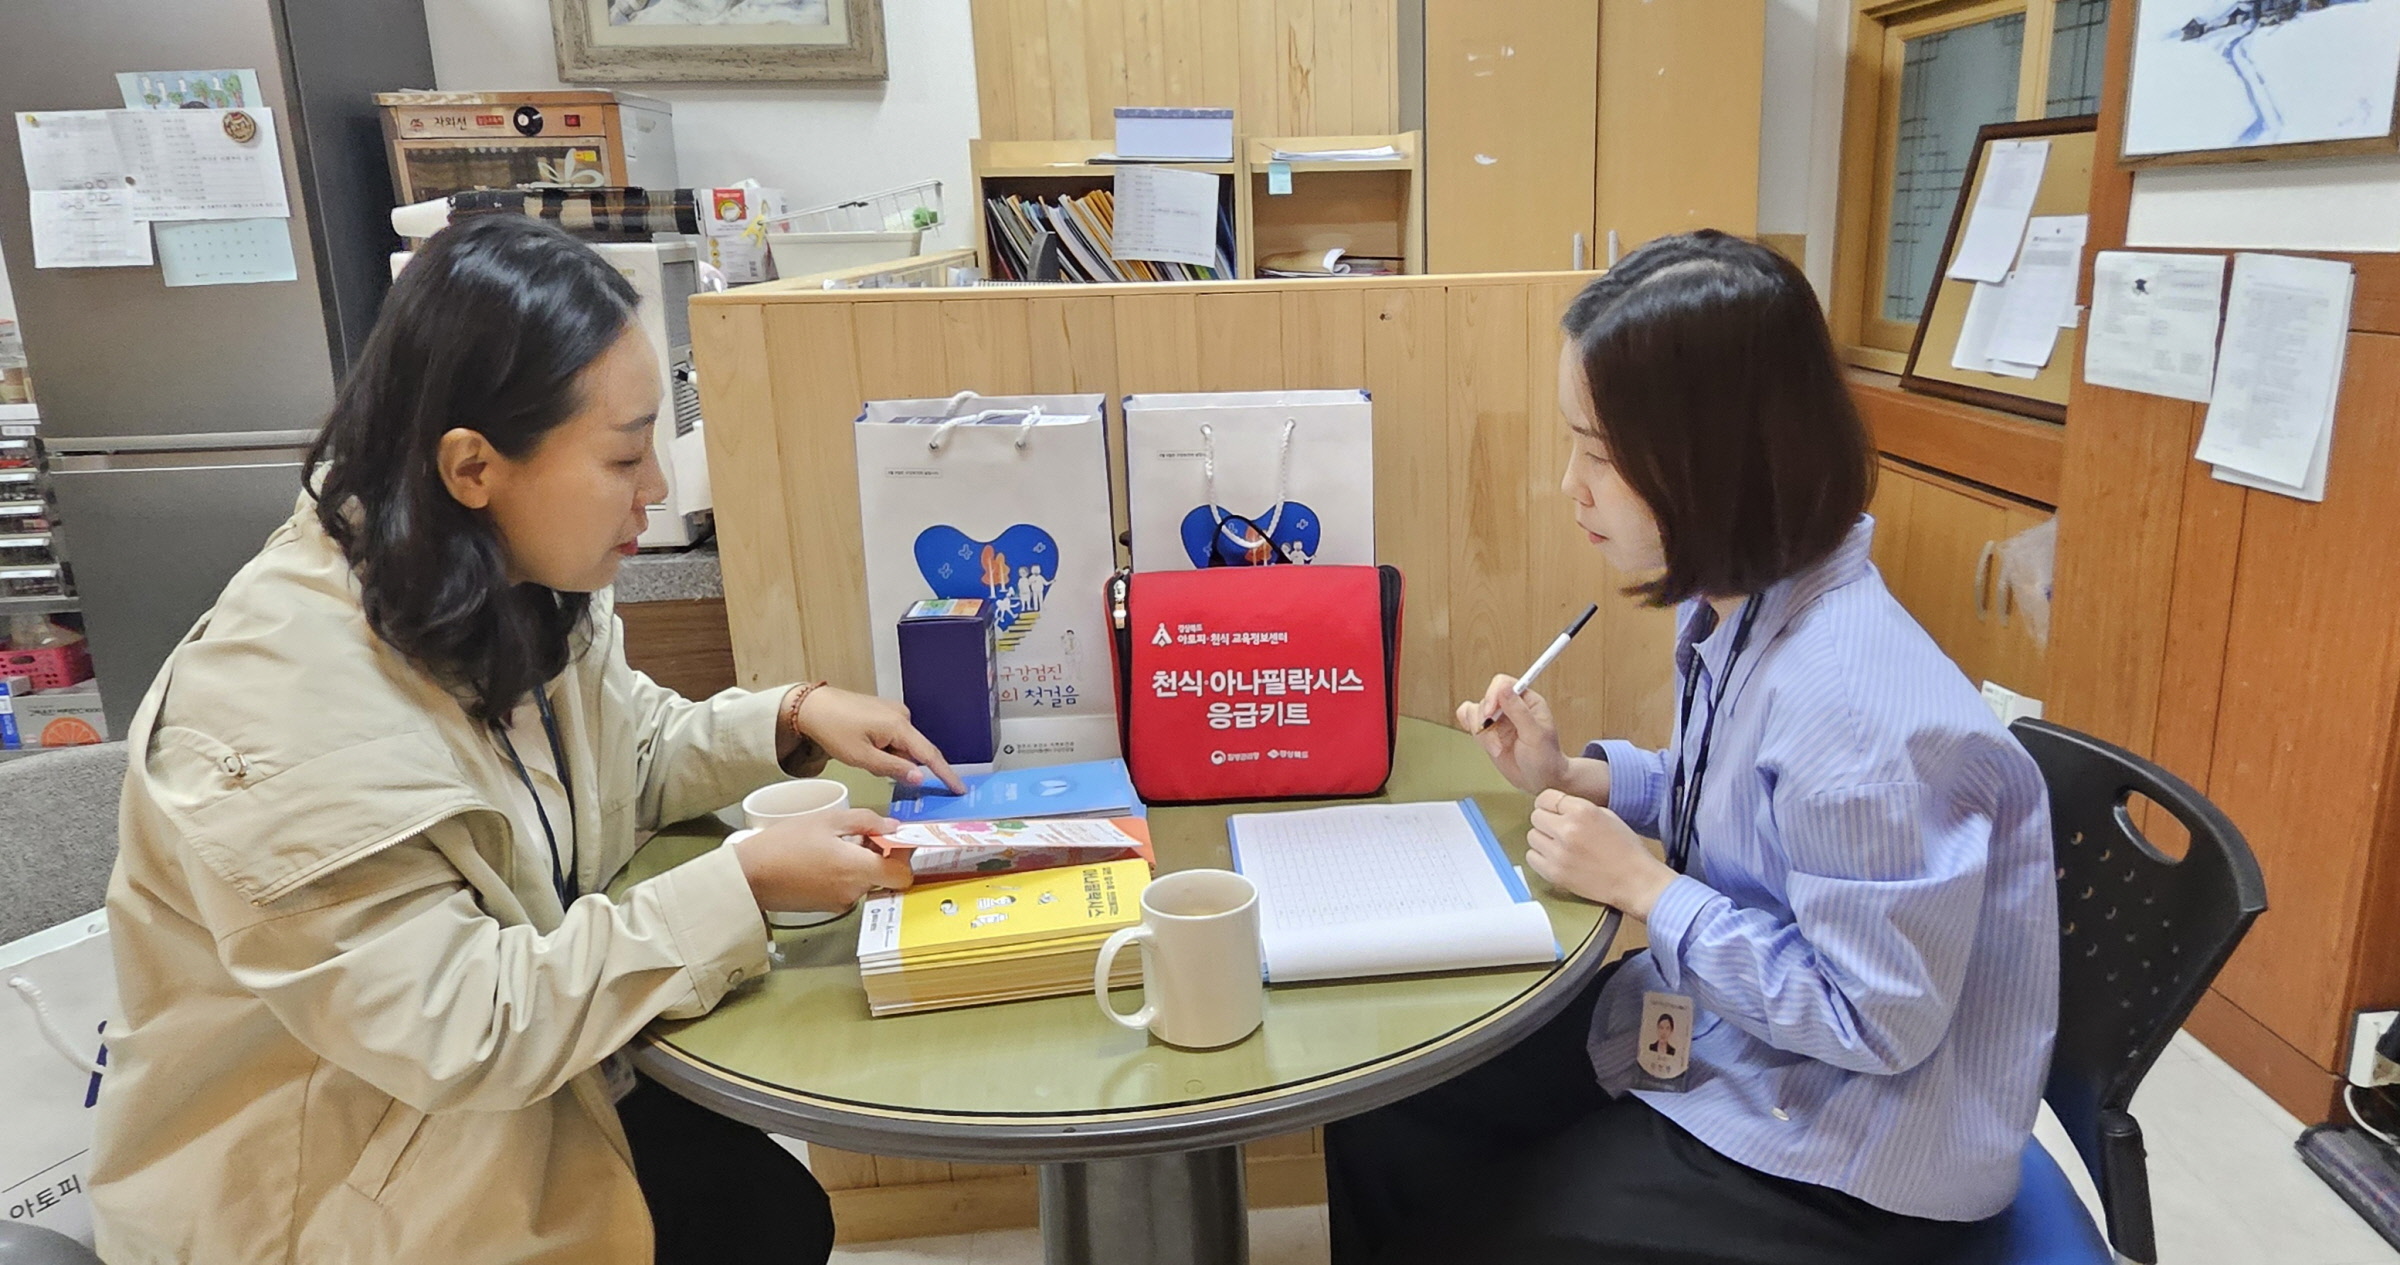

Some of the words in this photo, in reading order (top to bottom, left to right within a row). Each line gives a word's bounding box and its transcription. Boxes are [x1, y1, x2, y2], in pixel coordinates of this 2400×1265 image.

[433, 115, 468, 131] 자외선
[1177, 633, 1230, 646] 아토피·천식
[1231, 631, 1288, 646] 교육정보센터
[1000, 663, 1063, 682] 구강검진
[1151, 667, 1365, 698] 천식·아나필락시스
[1024, 684, 1080, 708] 첫걸음
[1206, 700, 1311, 730] 응급키트
[1082, 868, 1105, 918] 아나필락시스
[9, 1174, 82, 1219] 아토피
